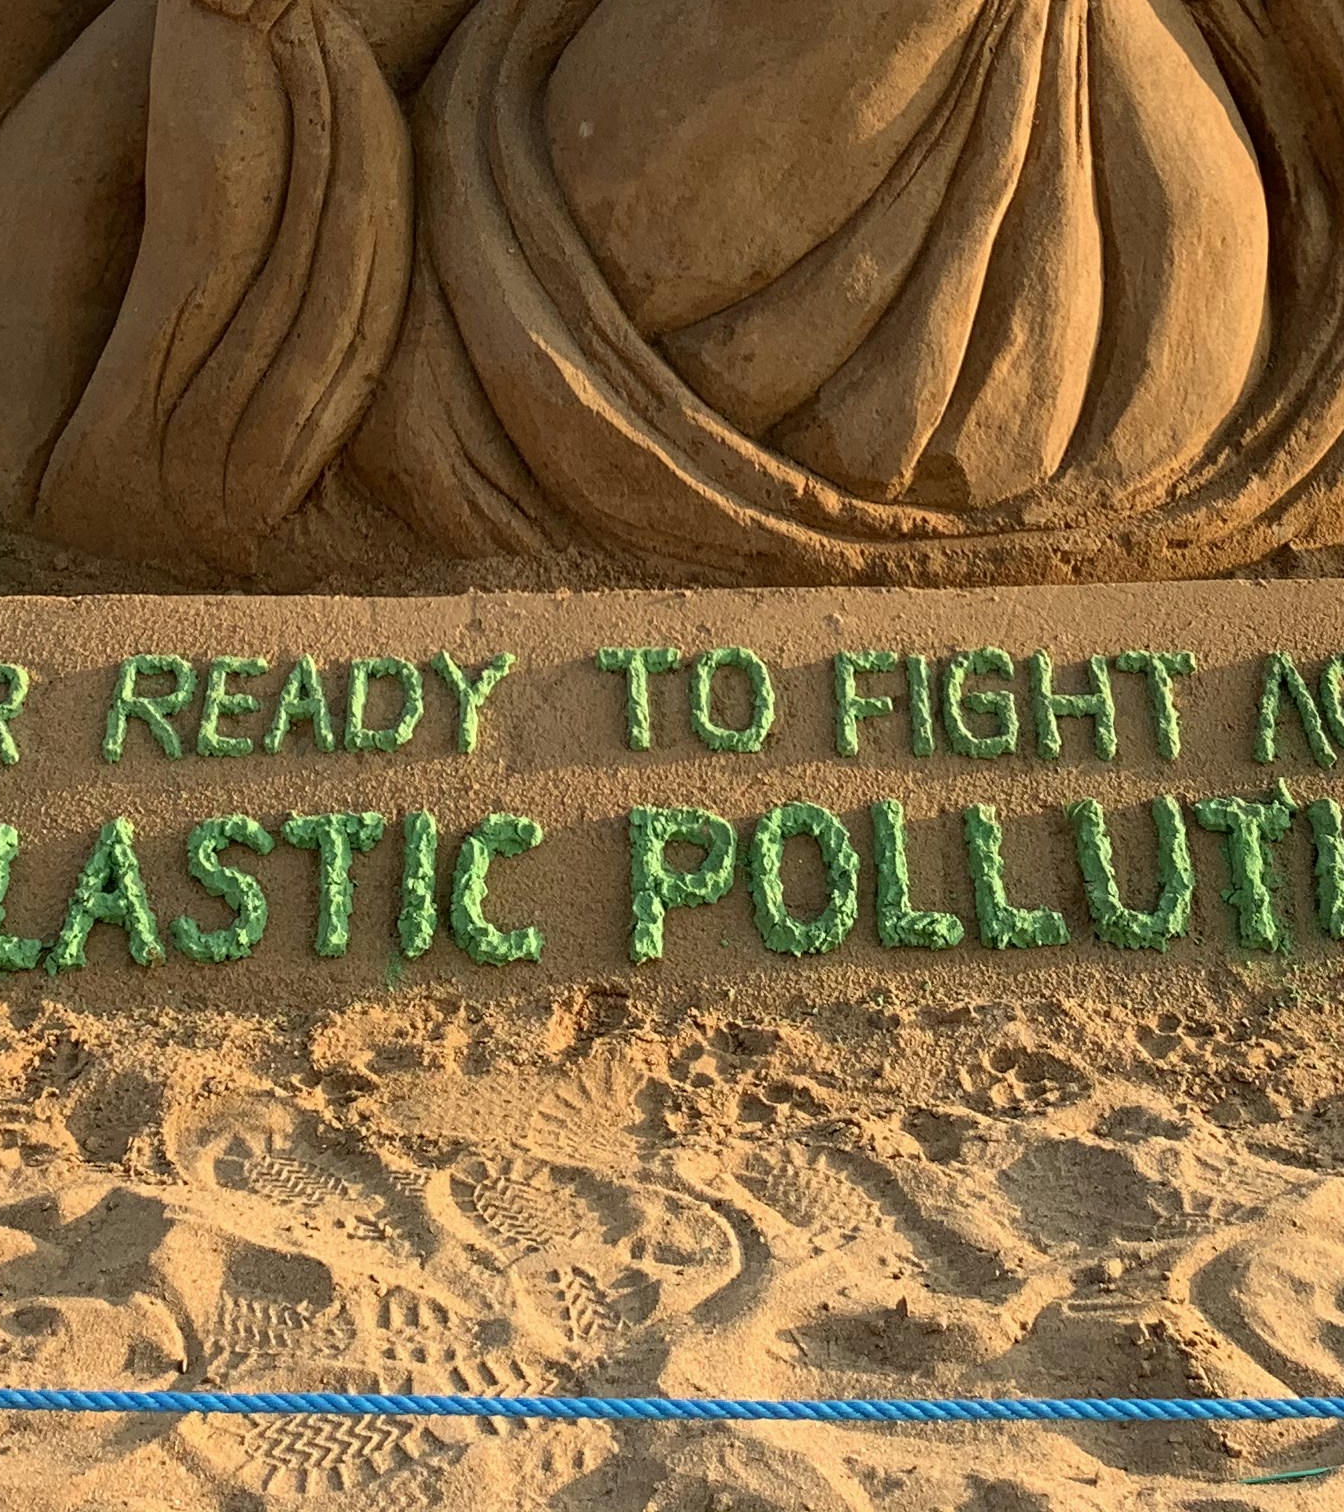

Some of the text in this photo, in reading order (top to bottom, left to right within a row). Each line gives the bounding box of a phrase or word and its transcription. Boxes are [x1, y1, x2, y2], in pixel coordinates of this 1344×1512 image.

[102, 650, 516, 764] READY
[594, 646, 775, 755] TO
[834, 647, 1197, 761] FIGHT
